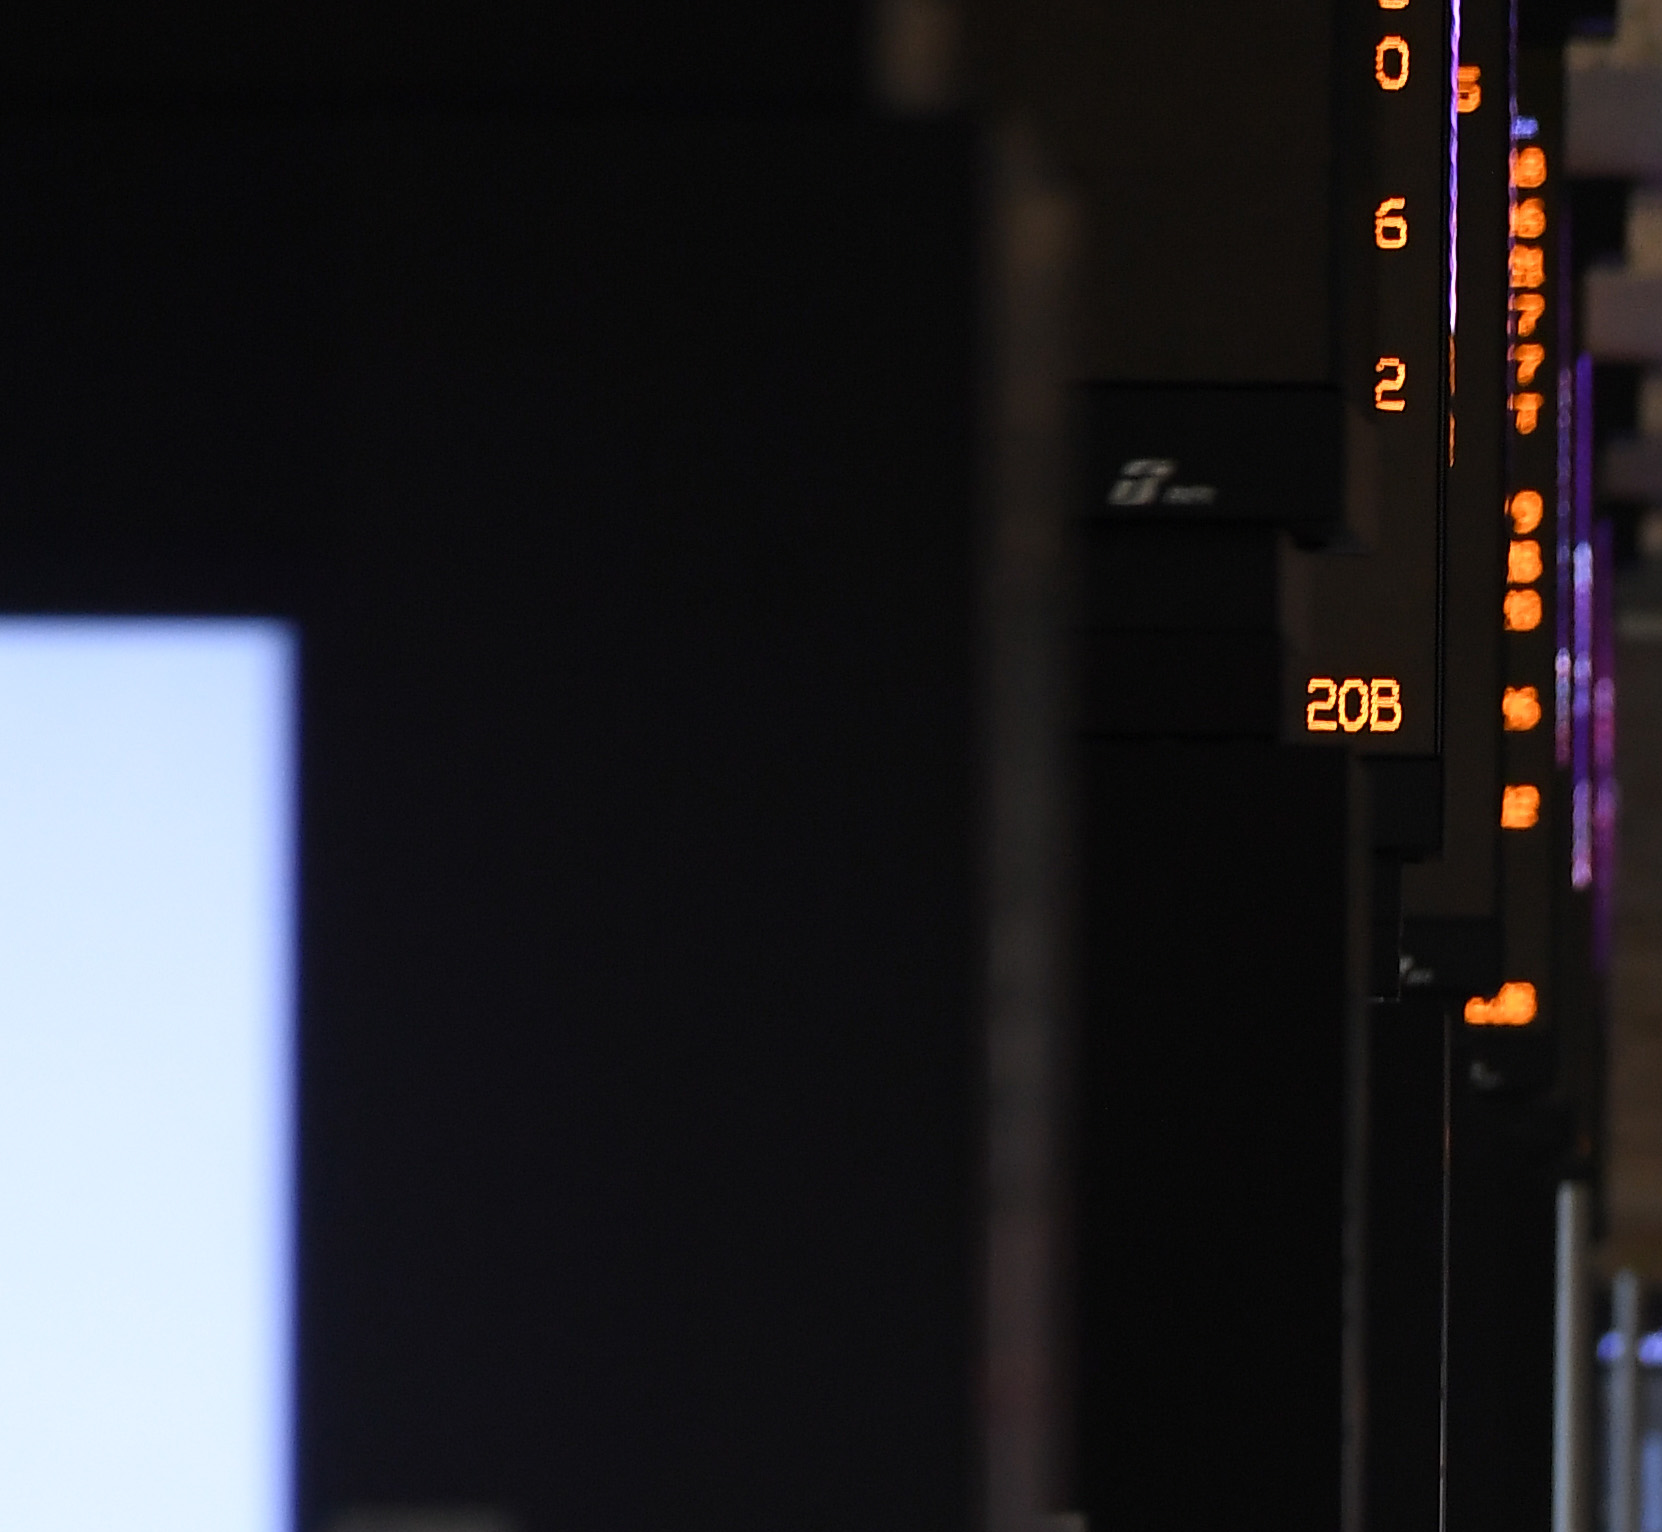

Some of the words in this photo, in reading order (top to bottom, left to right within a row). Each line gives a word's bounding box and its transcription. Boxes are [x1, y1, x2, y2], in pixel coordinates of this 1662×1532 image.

[1374, 198, 1408, 249] 6
[1374, 357, 1406, 411] 2
[1306, 678, 1402, 732] 20B
